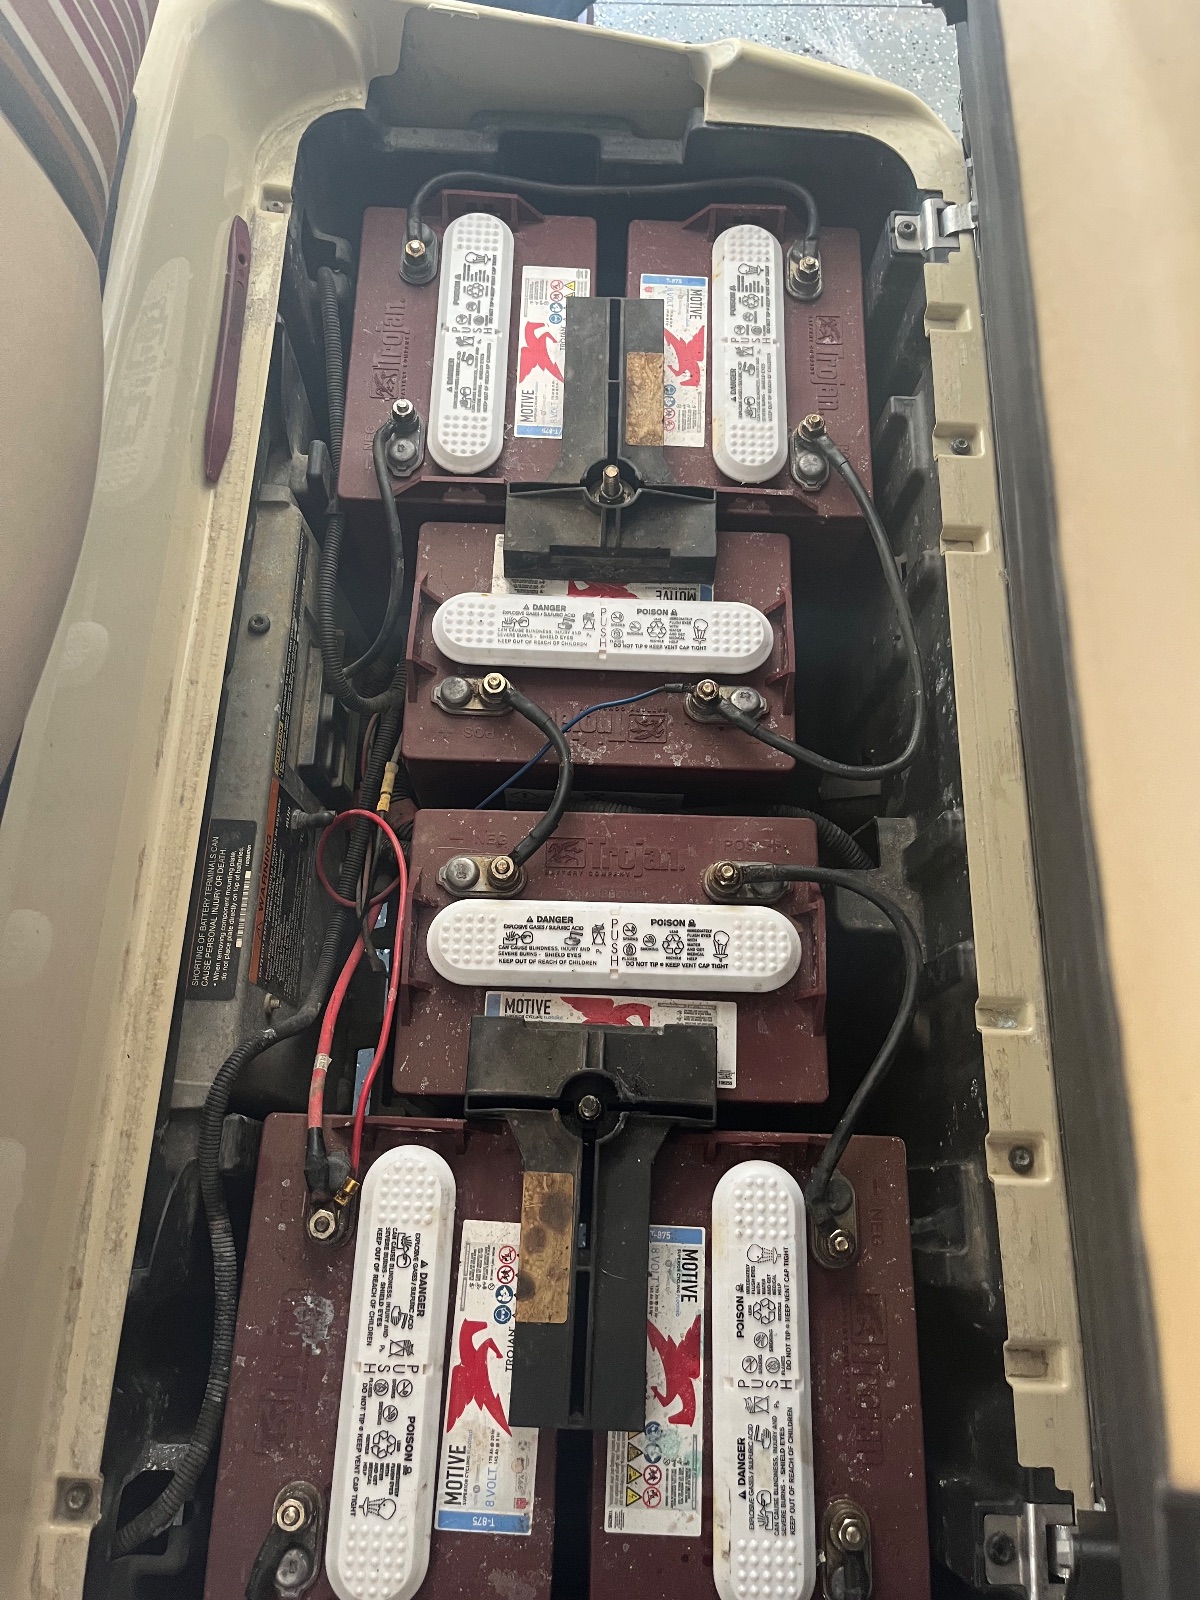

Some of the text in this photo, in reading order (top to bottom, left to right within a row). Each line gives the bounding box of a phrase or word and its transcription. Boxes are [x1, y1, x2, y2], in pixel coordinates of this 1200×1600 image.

[689, 289, 702, 319] MOTIVE
[520, 390, 534, 422] MOTIVE
[656, 590, 696, 601] MOTIVE
[228, 850, 237, 867] plate,
[235, 847, 244, 874] batteries.
[225, 868, 235, 895] mounting
[258, 834, 272, 912] WARNING
[192, 836, 219, 986] SHORTING OF BATTERY TERMINALS CAN
[232, 893, 238, 902] on
[200, 848, 227, 987] CAUSE PERSONAL INJURY OR DEATH.
[220, 897, 230, 931] component
[228, 903, 238, 925] directly
[216, 932, 226, 960] removing
[226, 926, 234, 941] plate
[504, 998, 551, 1015] MOTIVE
[374, 1263, 379, 1272] OF
[386, 1263, 395, 1299] BLINDNESS,
[651, 1256, 660, 1282] VOLT
[681, 1249, 699, 1303] MOTIVE
[370, 1299, 376, 1308] OF
[416, 1272, 428, 1318] DANGER
[366, 1311, 375, 1346] CHILDREN
[736, 1296, 744, 1338] POISON
[364, 1363, 419, 1373] PUSH
[785, 1360, 792, 1370] DO
[361, 1383, 368, 1393] DO
[738, 1379, 792, 1389] PUSH
[404, 1416, 416, 1462] POISON
[788, 1446, 793, 1456] OF
[444, 1444, 466, 1506] MOTIVE
[737, 1437, 746, 1486] DANGER
[486, 1468, 497, 1497] VOLT
[788, 1485, 794, 1496] OF
[472, 1517, 495, 1526] T-875
